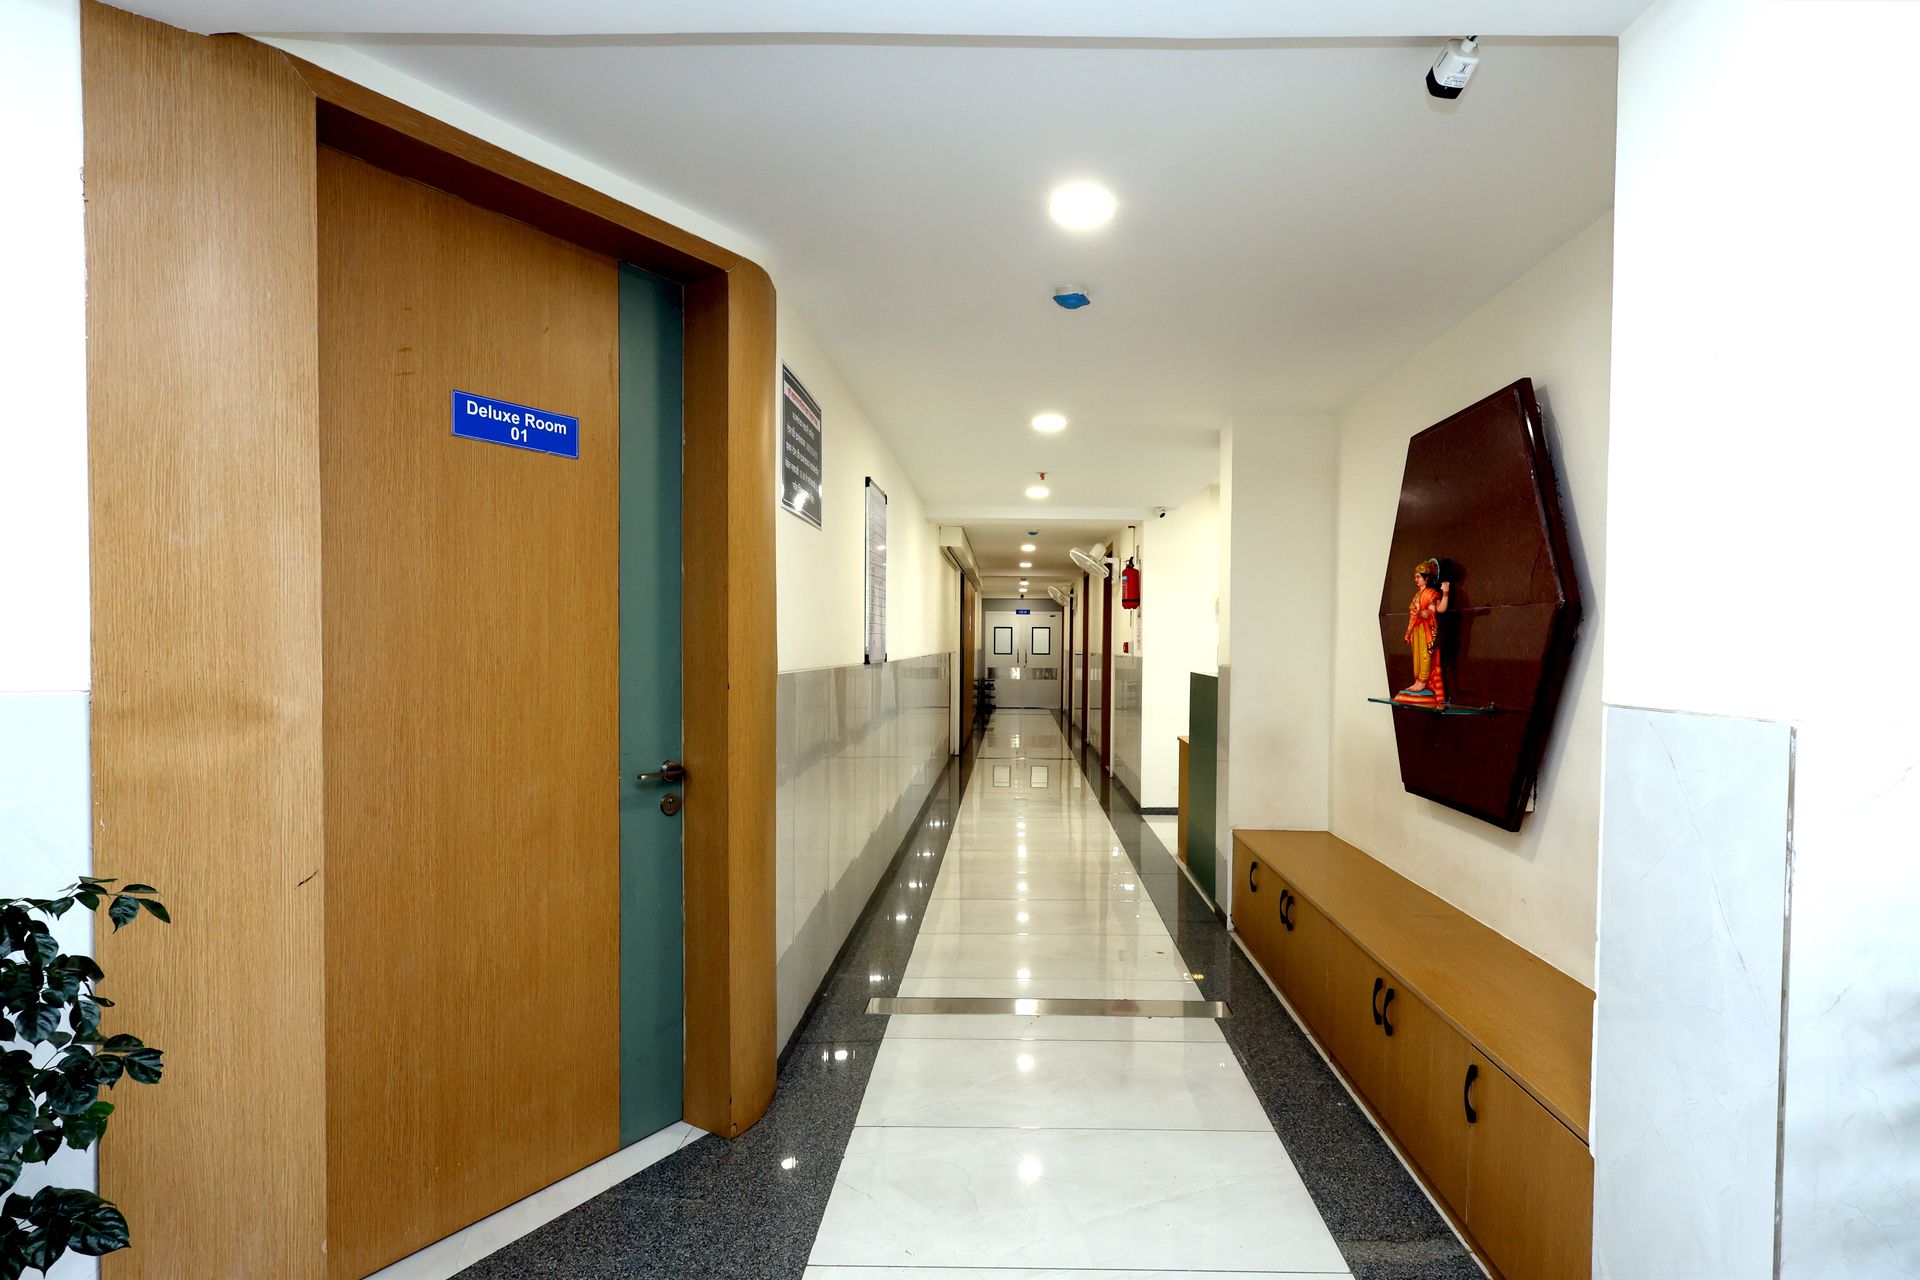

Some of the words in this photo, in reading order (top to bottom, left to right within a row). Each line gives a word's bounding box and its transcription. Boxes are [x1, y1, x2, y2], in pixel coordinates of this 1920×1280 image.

[466, 400, 520, 425] Deluxe
[525, 413, 567, 435] Room
[510, 427, 527, 442] 01
